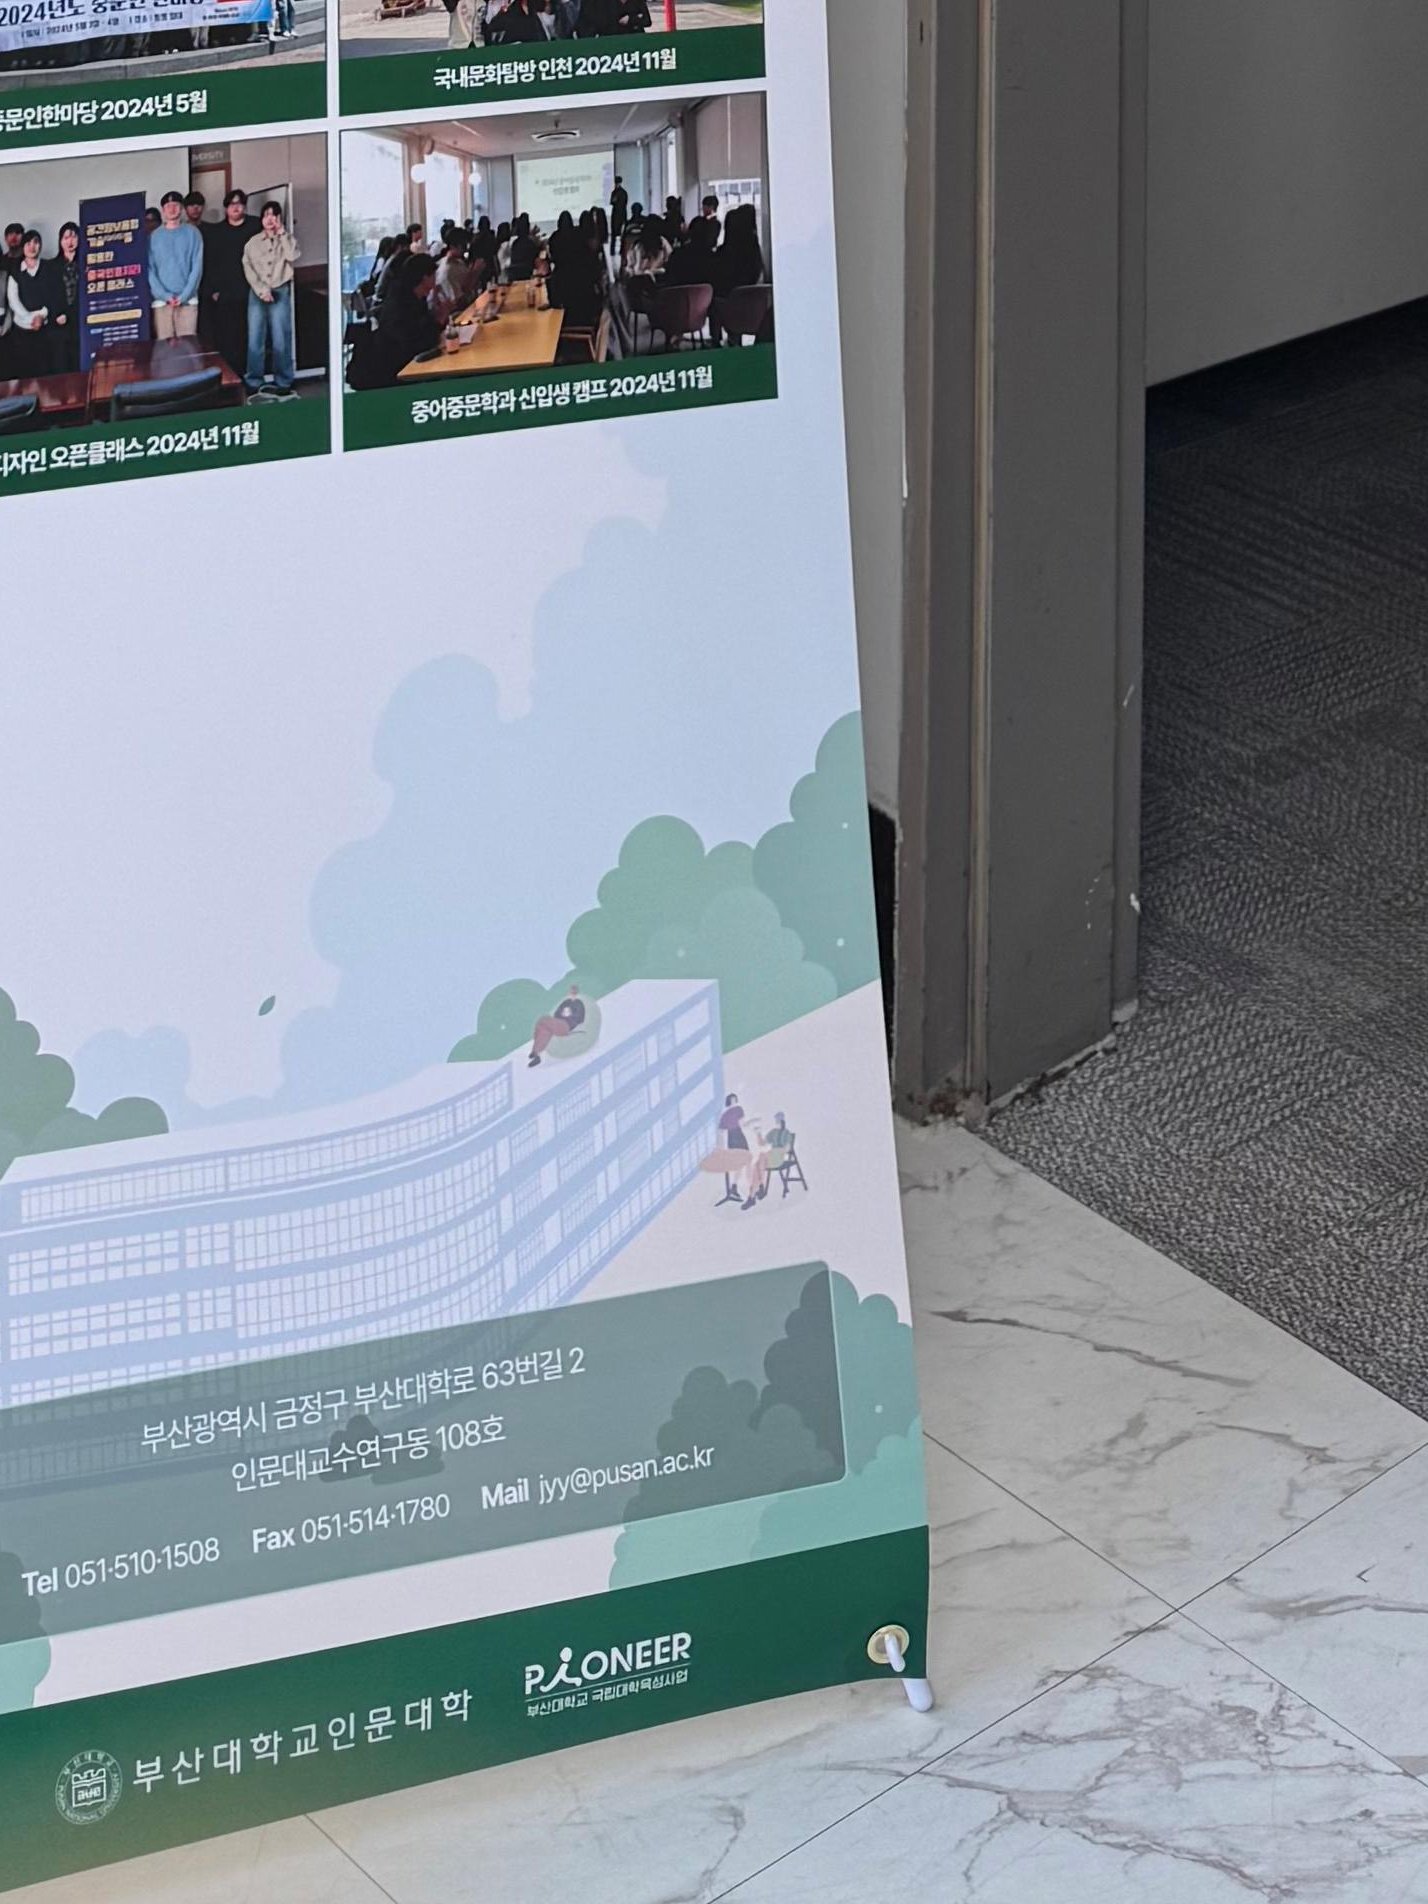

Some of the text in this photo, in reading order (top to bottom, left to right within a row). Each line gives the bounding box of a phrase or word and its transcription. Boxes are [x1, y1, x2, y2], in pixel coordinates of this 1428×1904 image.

[434, 48, 676, 89] 국내문화탐방 인천 2024년 11월
[101, 93, 172, 120] 2024년
[176, 90, 206, 113] 5월
[412, 366, 712, 423] 중어중문학과 신입생 캠프 2024년 11월
[50, 438, 144, 468] 오픈클래스
[147, 426, 218, 456] 2024년
[222, 421, 259, 446] 11월
[142, 1347, 585, 1453] 부산광역시 금정구 부산대학로 63번길 2
[232, 1415, 506, 1491] 인문대교수연구동 108호
[482, 1446, 714, 1509] Mail jyy@pusan.ac.kr
